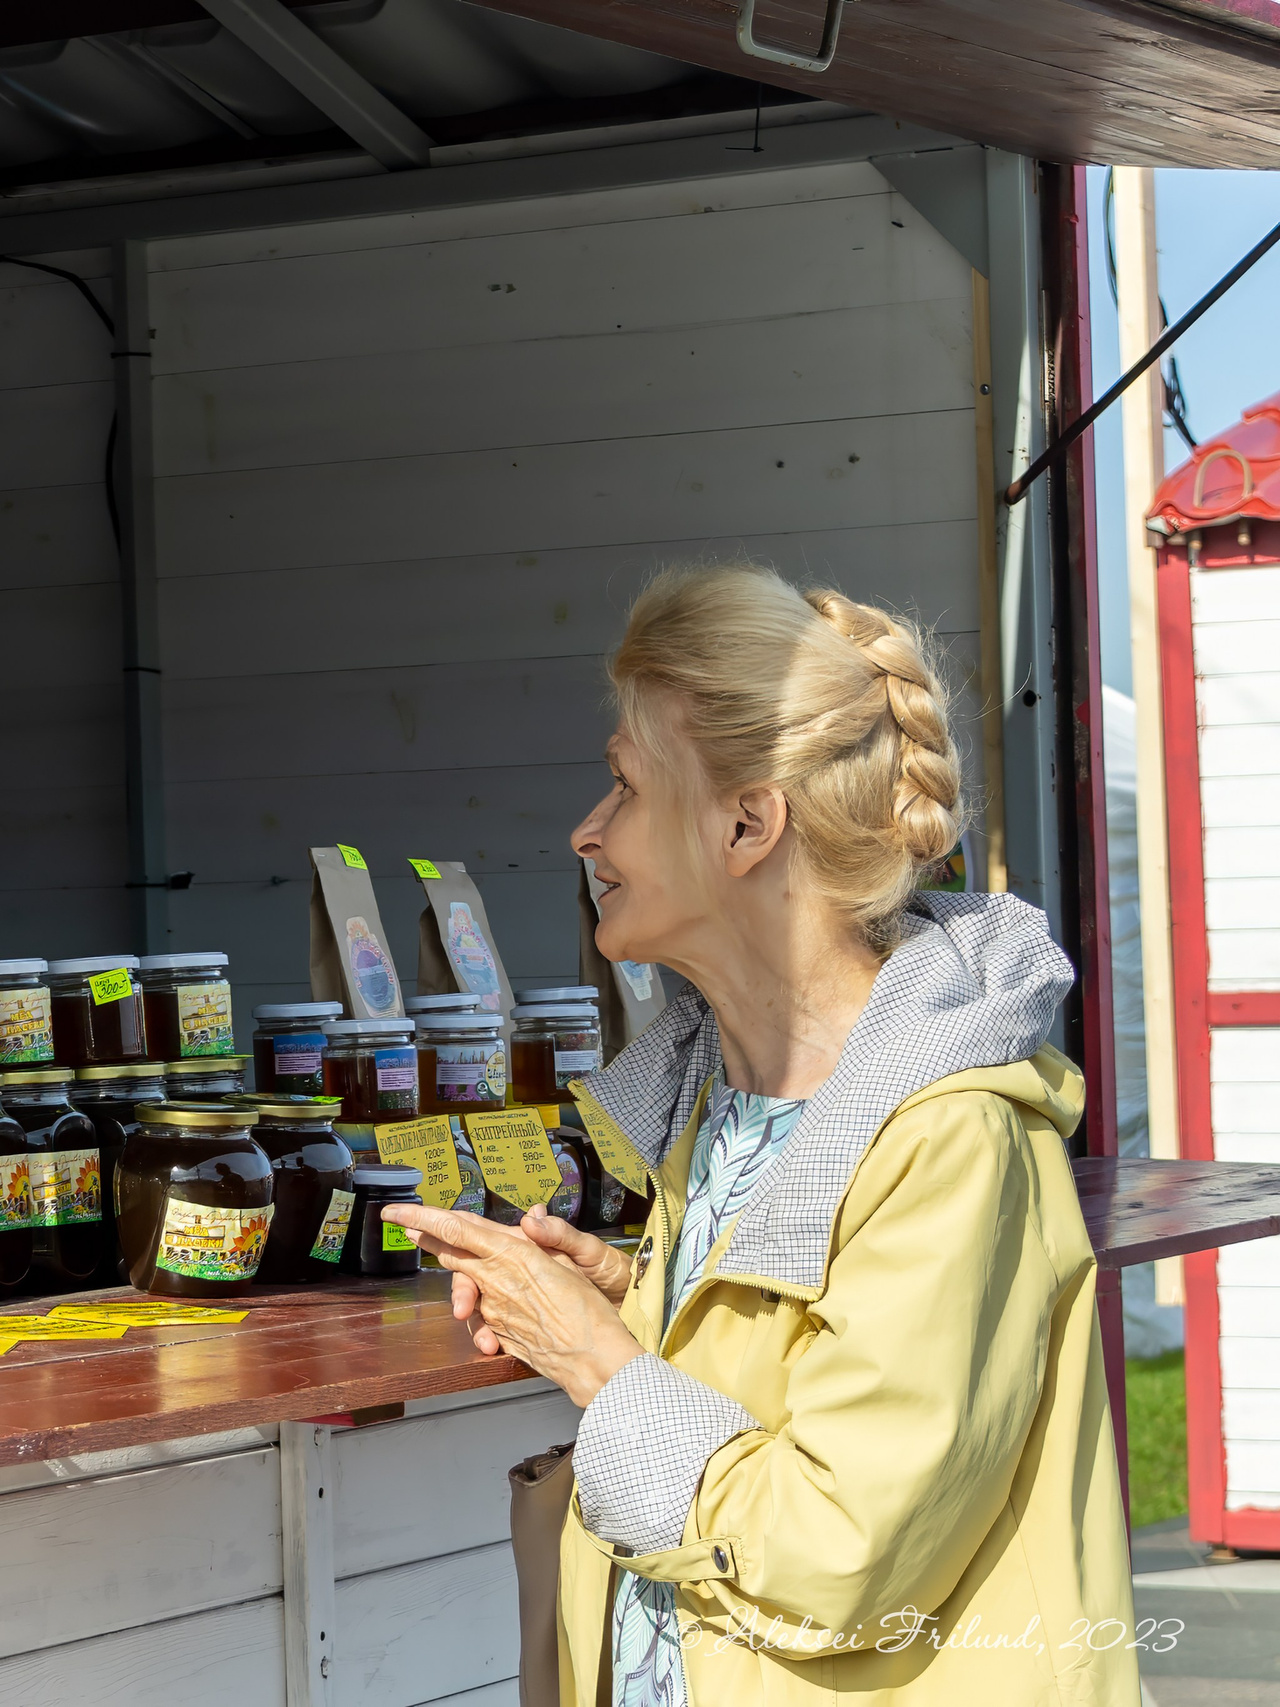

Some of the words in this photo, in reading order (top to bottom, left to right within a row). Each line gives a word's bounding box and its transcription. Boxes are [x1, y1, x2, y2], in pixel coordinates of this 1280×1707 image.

[10, 1009, 33, 1021] МЁД
[7, 1019, 45, 1034] ПАСЕКИ
[184, 1224, 209, 1237] МЁД
[177, 1236, 223, 1248] ПАСЕКИ
